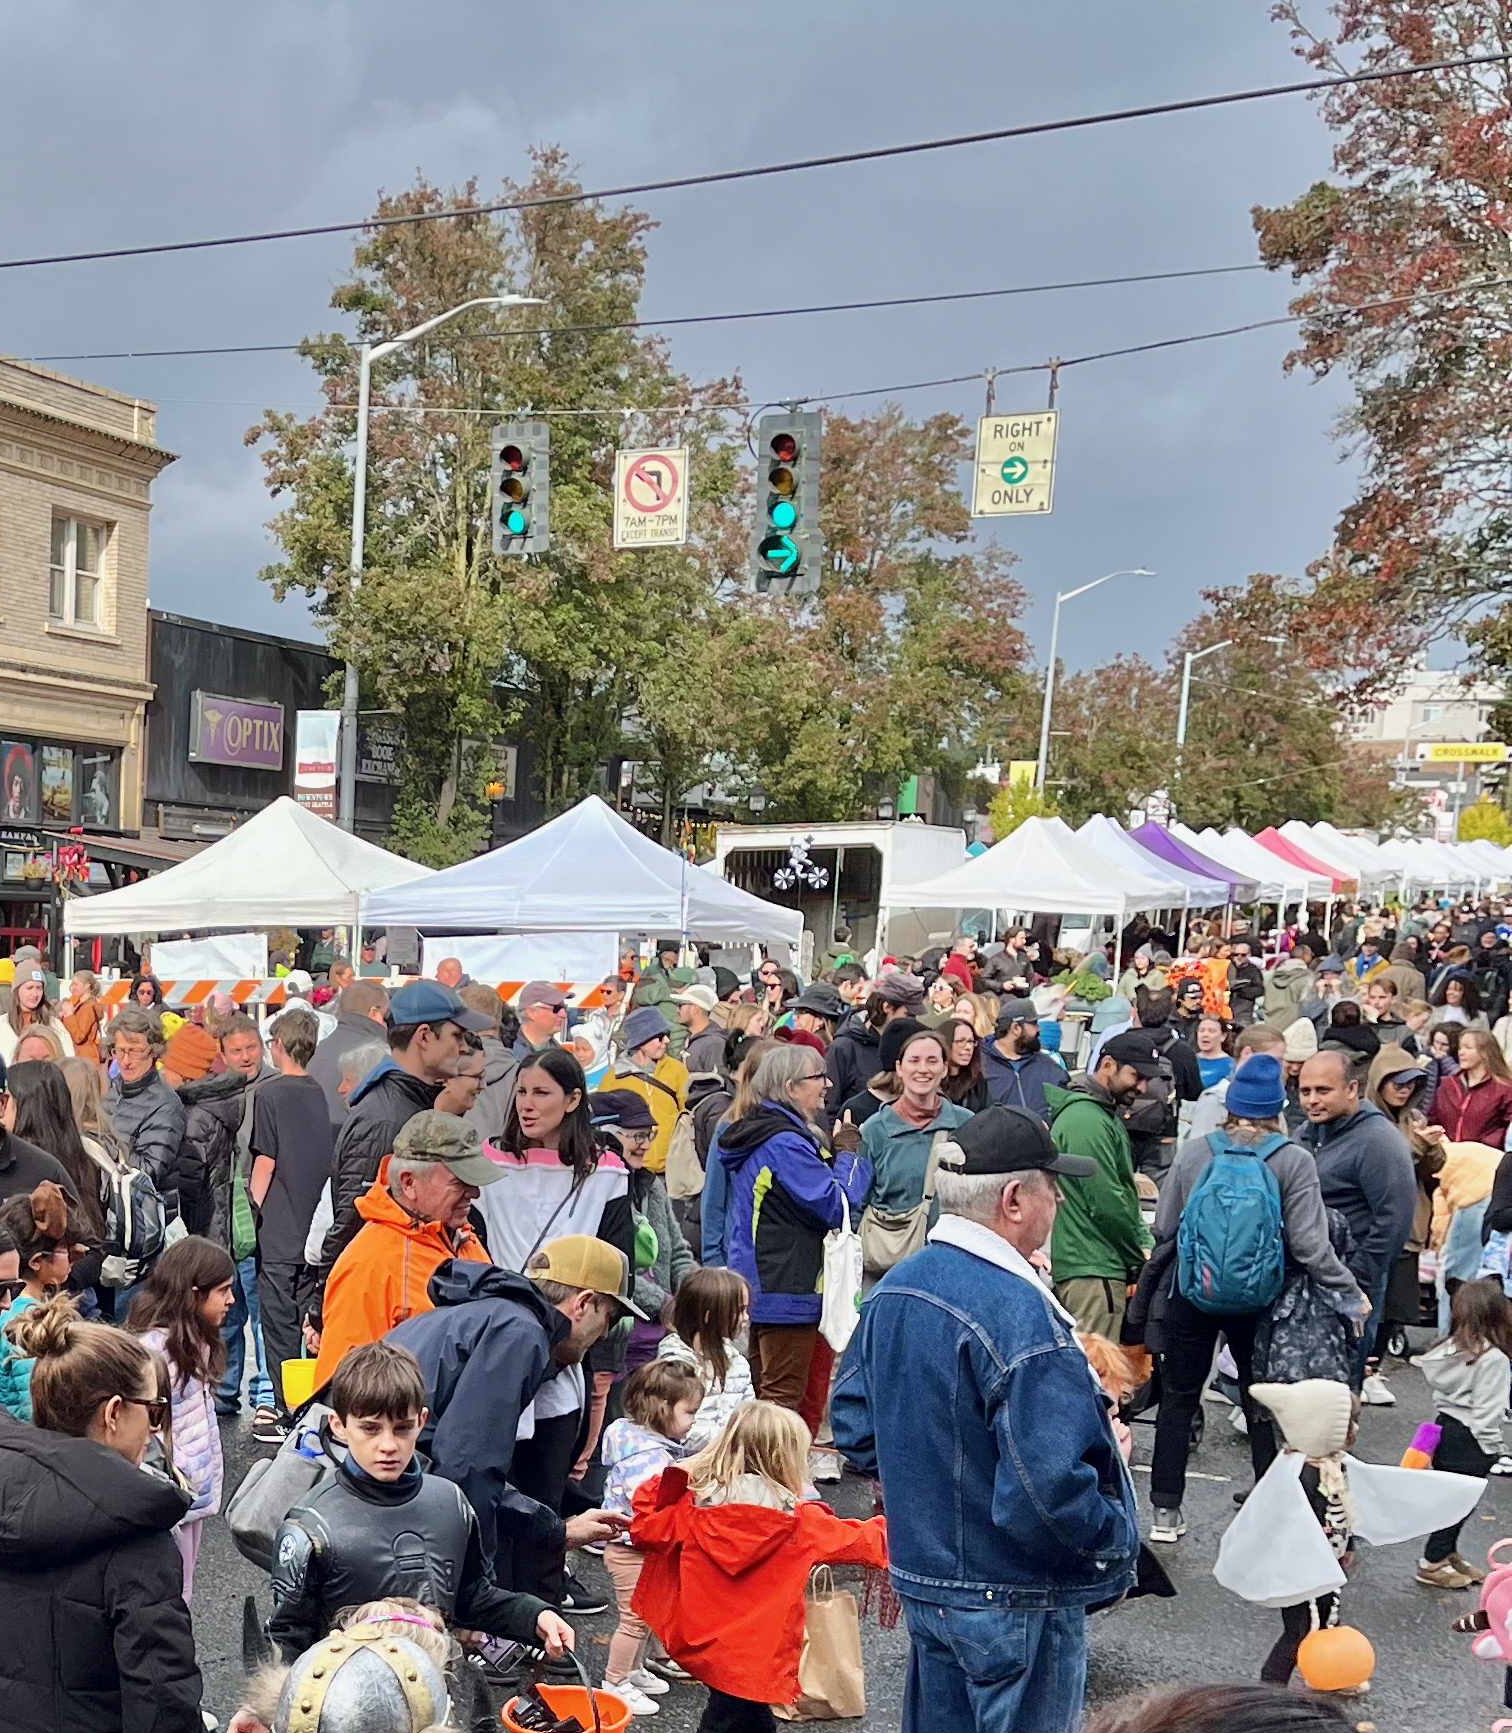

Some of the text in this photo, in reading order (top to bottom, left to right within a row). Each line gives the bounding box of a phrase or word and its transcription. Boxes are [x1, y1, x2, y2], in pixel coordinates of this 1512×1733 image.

[993, 420, 1043, 439] RIGHT
[1008, 441, 1025, 452] ON
[991, 488, 1034, 505] ONLY
[621, 527, 679, 540] EXCEPT TRANSIT
[226, 715, 281, 753] OPTIX
[1434, 748, 1499, 757] CROSSWALK
